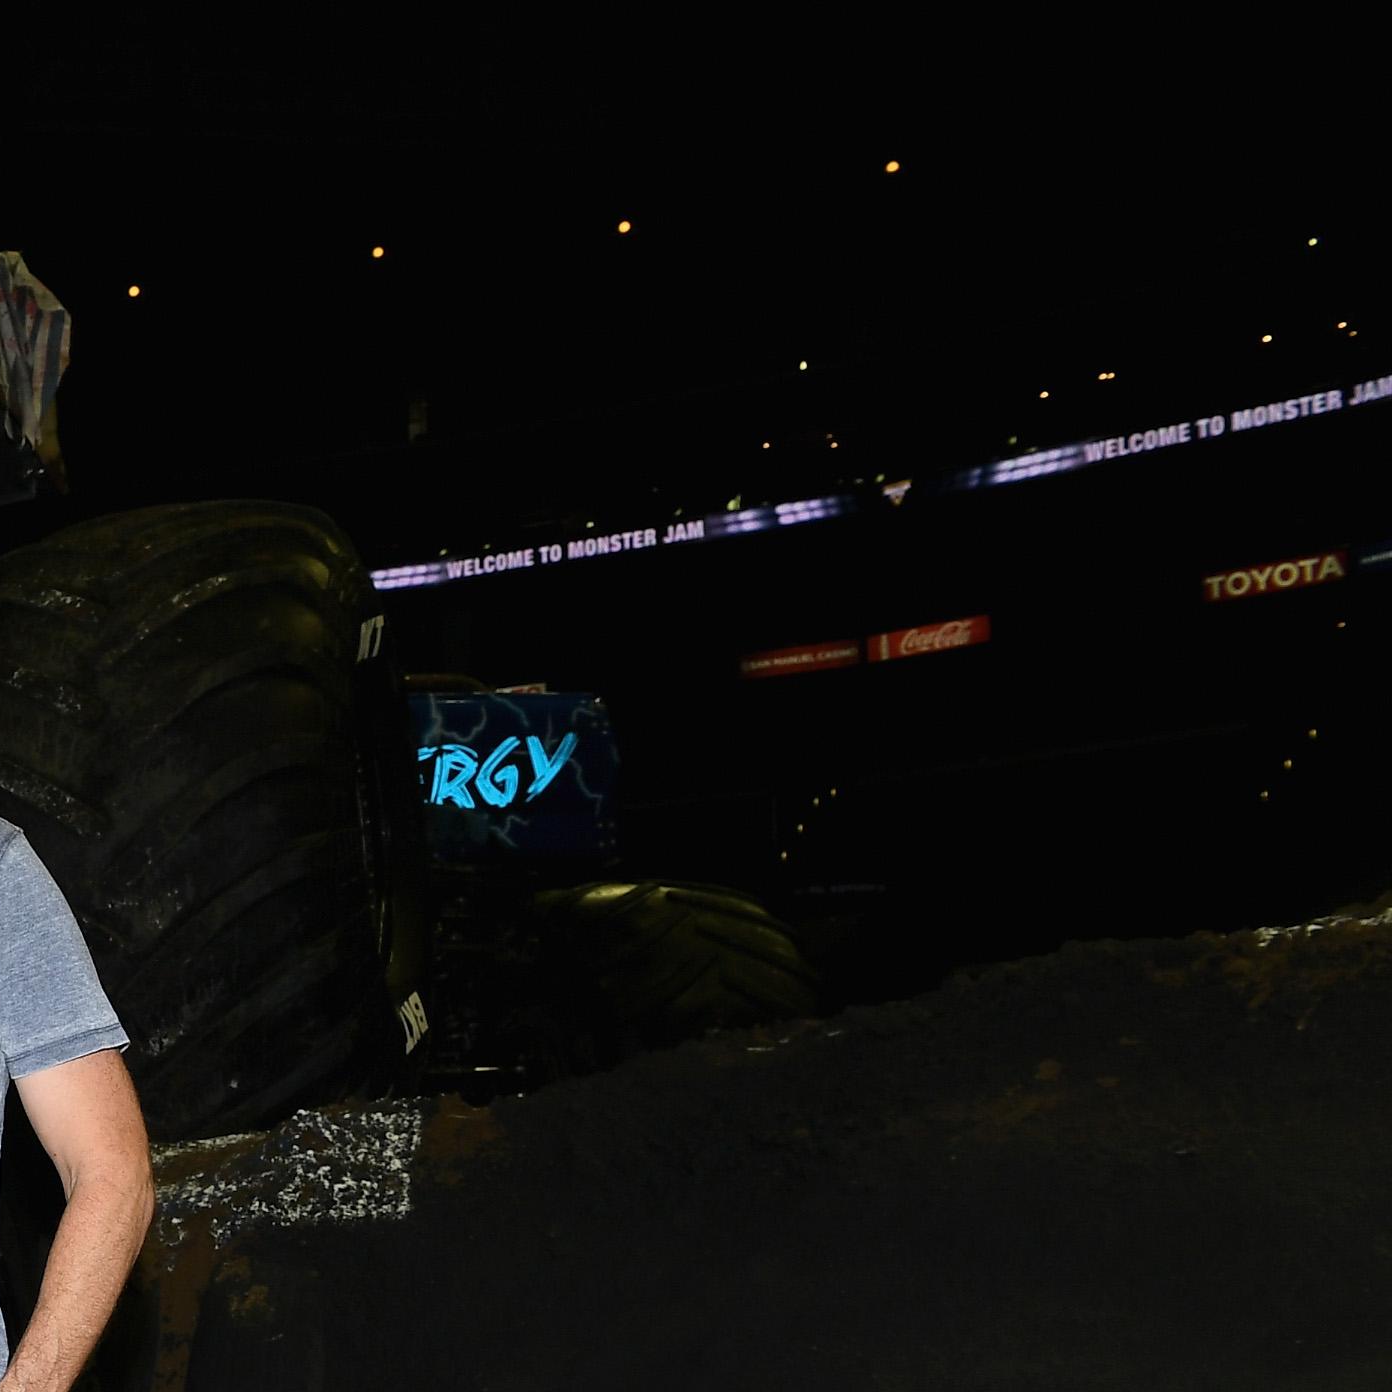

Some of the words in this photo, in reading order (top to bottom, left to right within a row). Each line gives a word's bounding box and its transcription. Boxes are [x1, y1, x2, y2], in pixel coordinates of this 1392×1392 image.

[1085, 422, 1191, 462] WELCOME
[1196, 415, 1225, 439] TO
[1231, 390, 1342, 432] MONSTER
[447, 550, 534, 580] WELCOME
[539, 545, 562, 564] TO
[568, 528, 656, 559] MONSTER
[663, 520, 704, 544] JAM
[1204, 554, 1344, 599] TOYOTA
[417, 732, 579, 809] RGY
